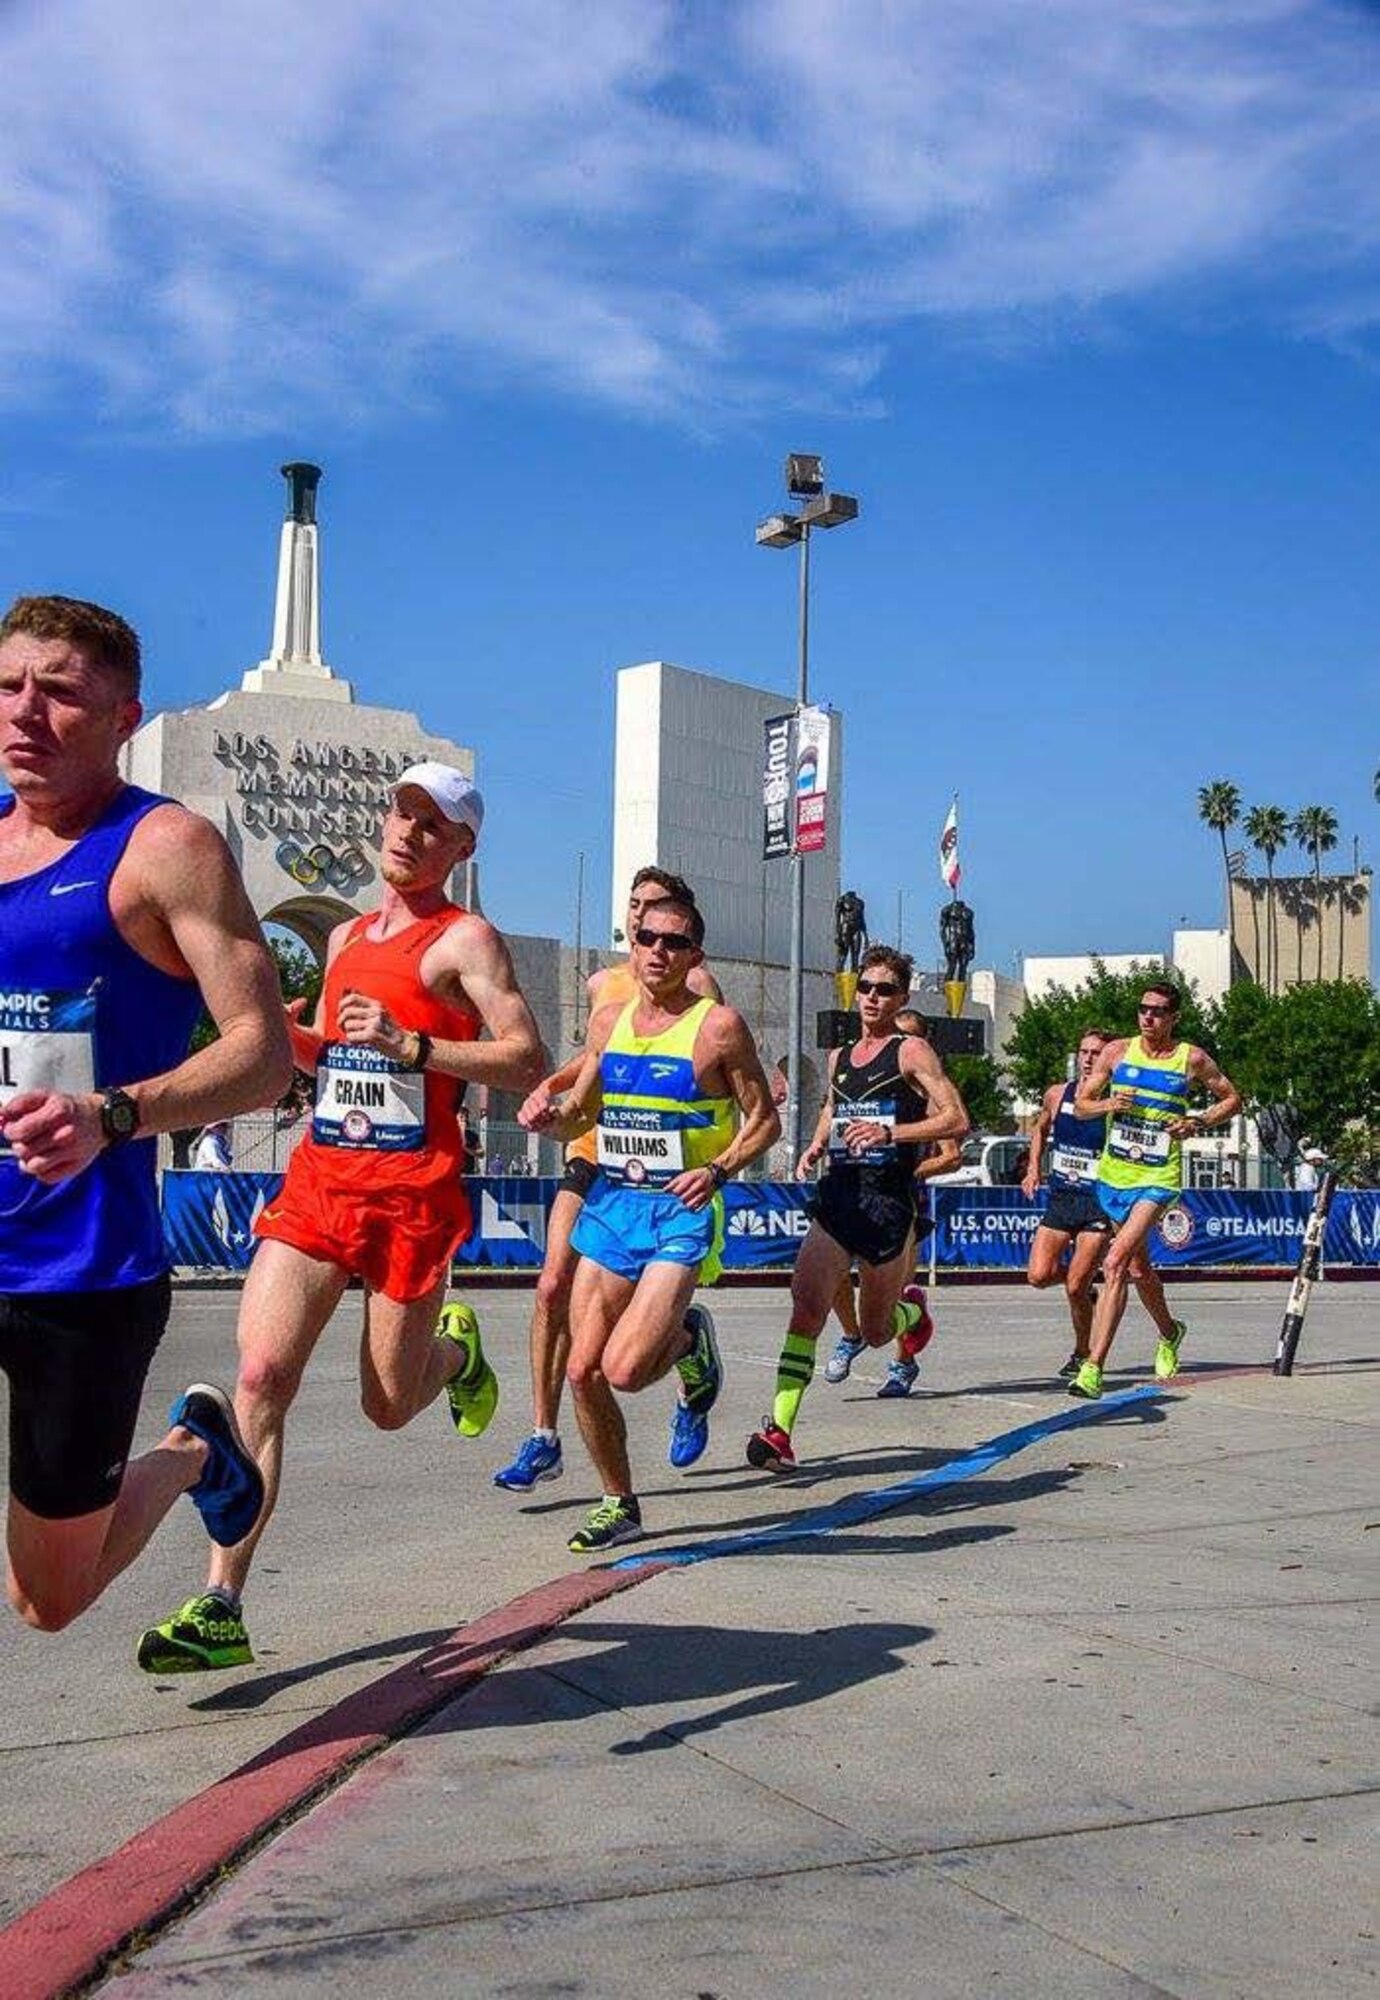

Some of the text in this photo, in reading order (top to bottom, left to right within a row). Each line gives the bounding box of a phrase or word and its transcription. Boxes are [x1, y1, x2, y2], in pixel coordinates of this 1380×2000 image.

[213, 729, 270, 760] LOS
[235, 770, 392, 806] MEMORIA
[242, 802, 377, 838] COLISEU
[0, 991, 51, 1014] MPIC
[0, 1013, 50, 1030] IALS
[0, 1046, 18, 1088] L
[335, 1079, 385, 1107] CRAIN
[602, 1132, 669, 1158] WILLIAMS
[768, 1209, 811, 1236] NB
[949, 1213, 1045, 1231] U.S. OLYMP
[1205, 1216, 1306, 1237] @TEAMUSA
[949, 1231, 1037, 1245] TEAM TRIA
[193, 1615, 246, 1641] Reebo
